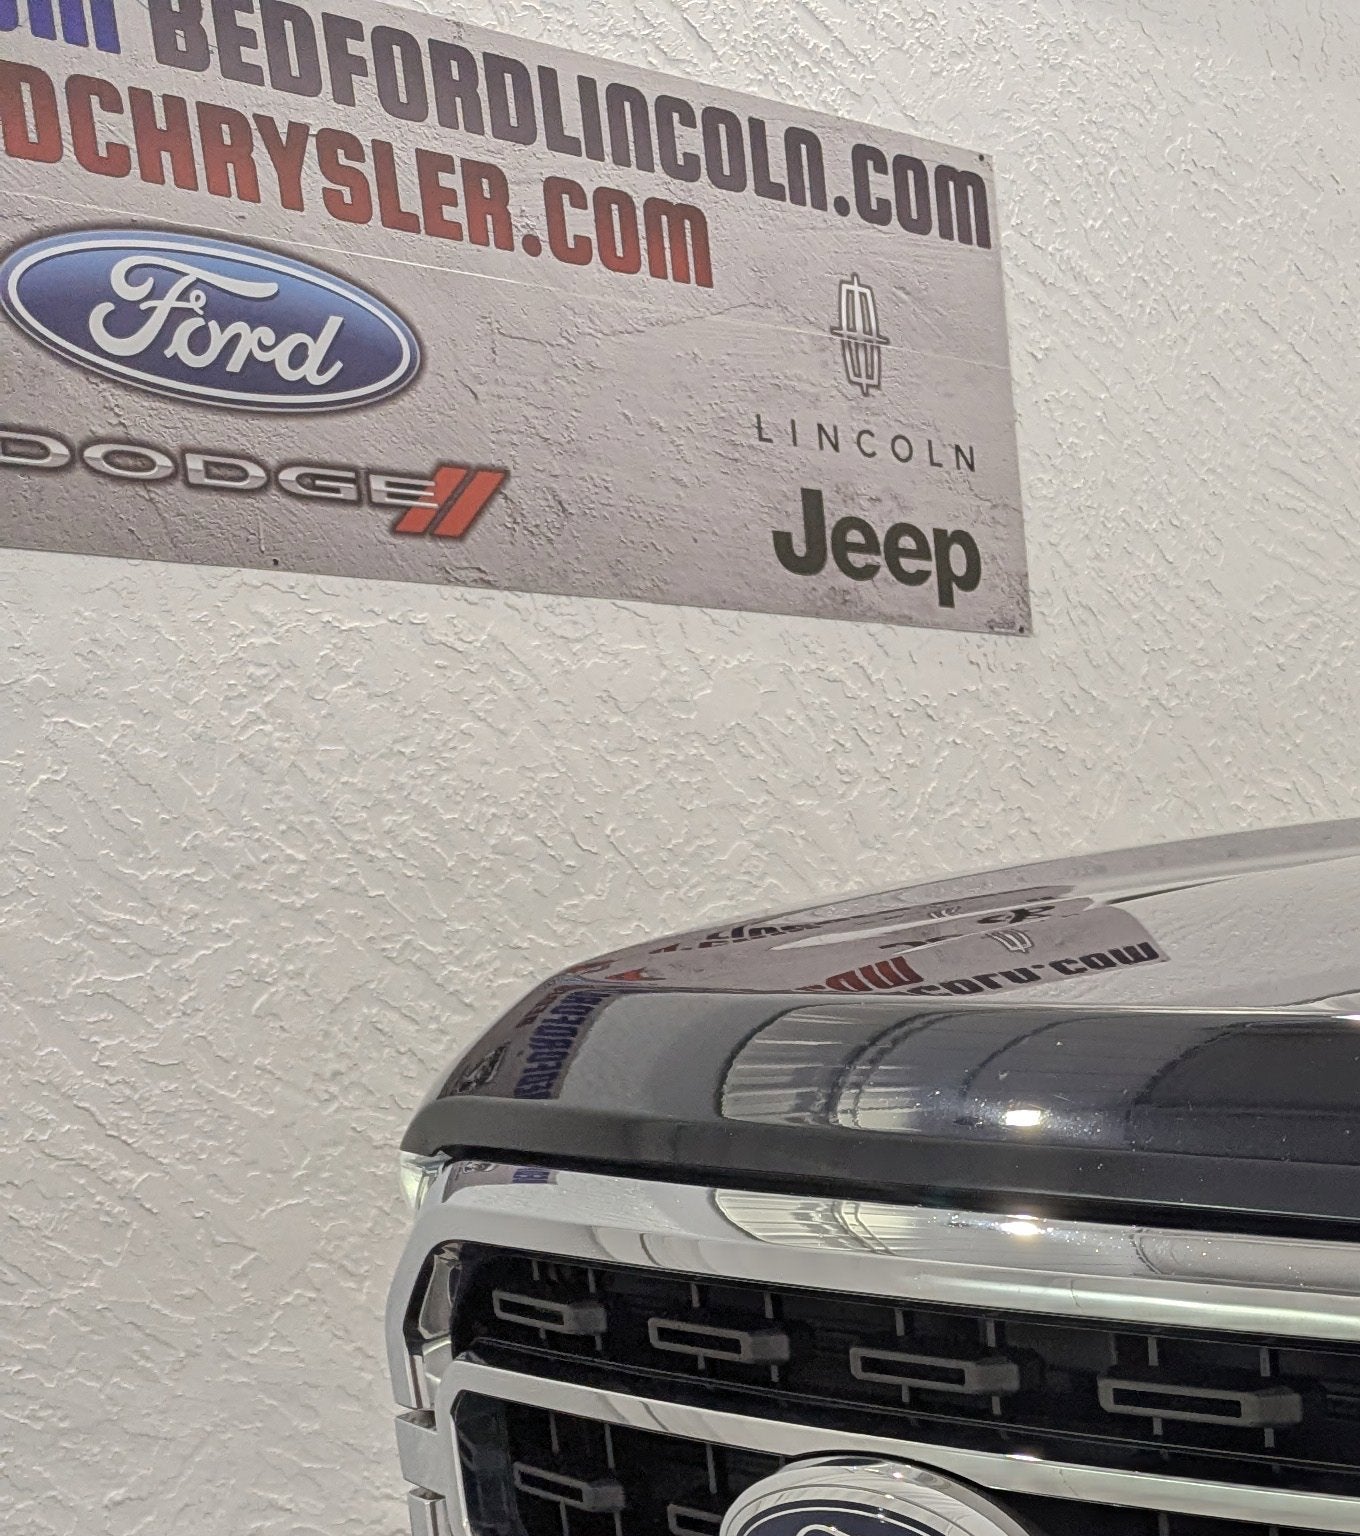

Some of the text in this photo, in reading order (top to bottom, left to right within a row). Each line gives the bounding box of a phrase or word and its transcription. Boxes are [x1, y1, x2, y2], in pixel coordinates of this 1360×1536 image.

[148, 0, 991, 249] BEDFORDLINCOLN.COM
[89, 255, 344, 386] Ford
[0, 430, 439, 509] DODGE
[756, 413, 976, 472] LINCOLN
[772, 487, 982, 609] Jeep
